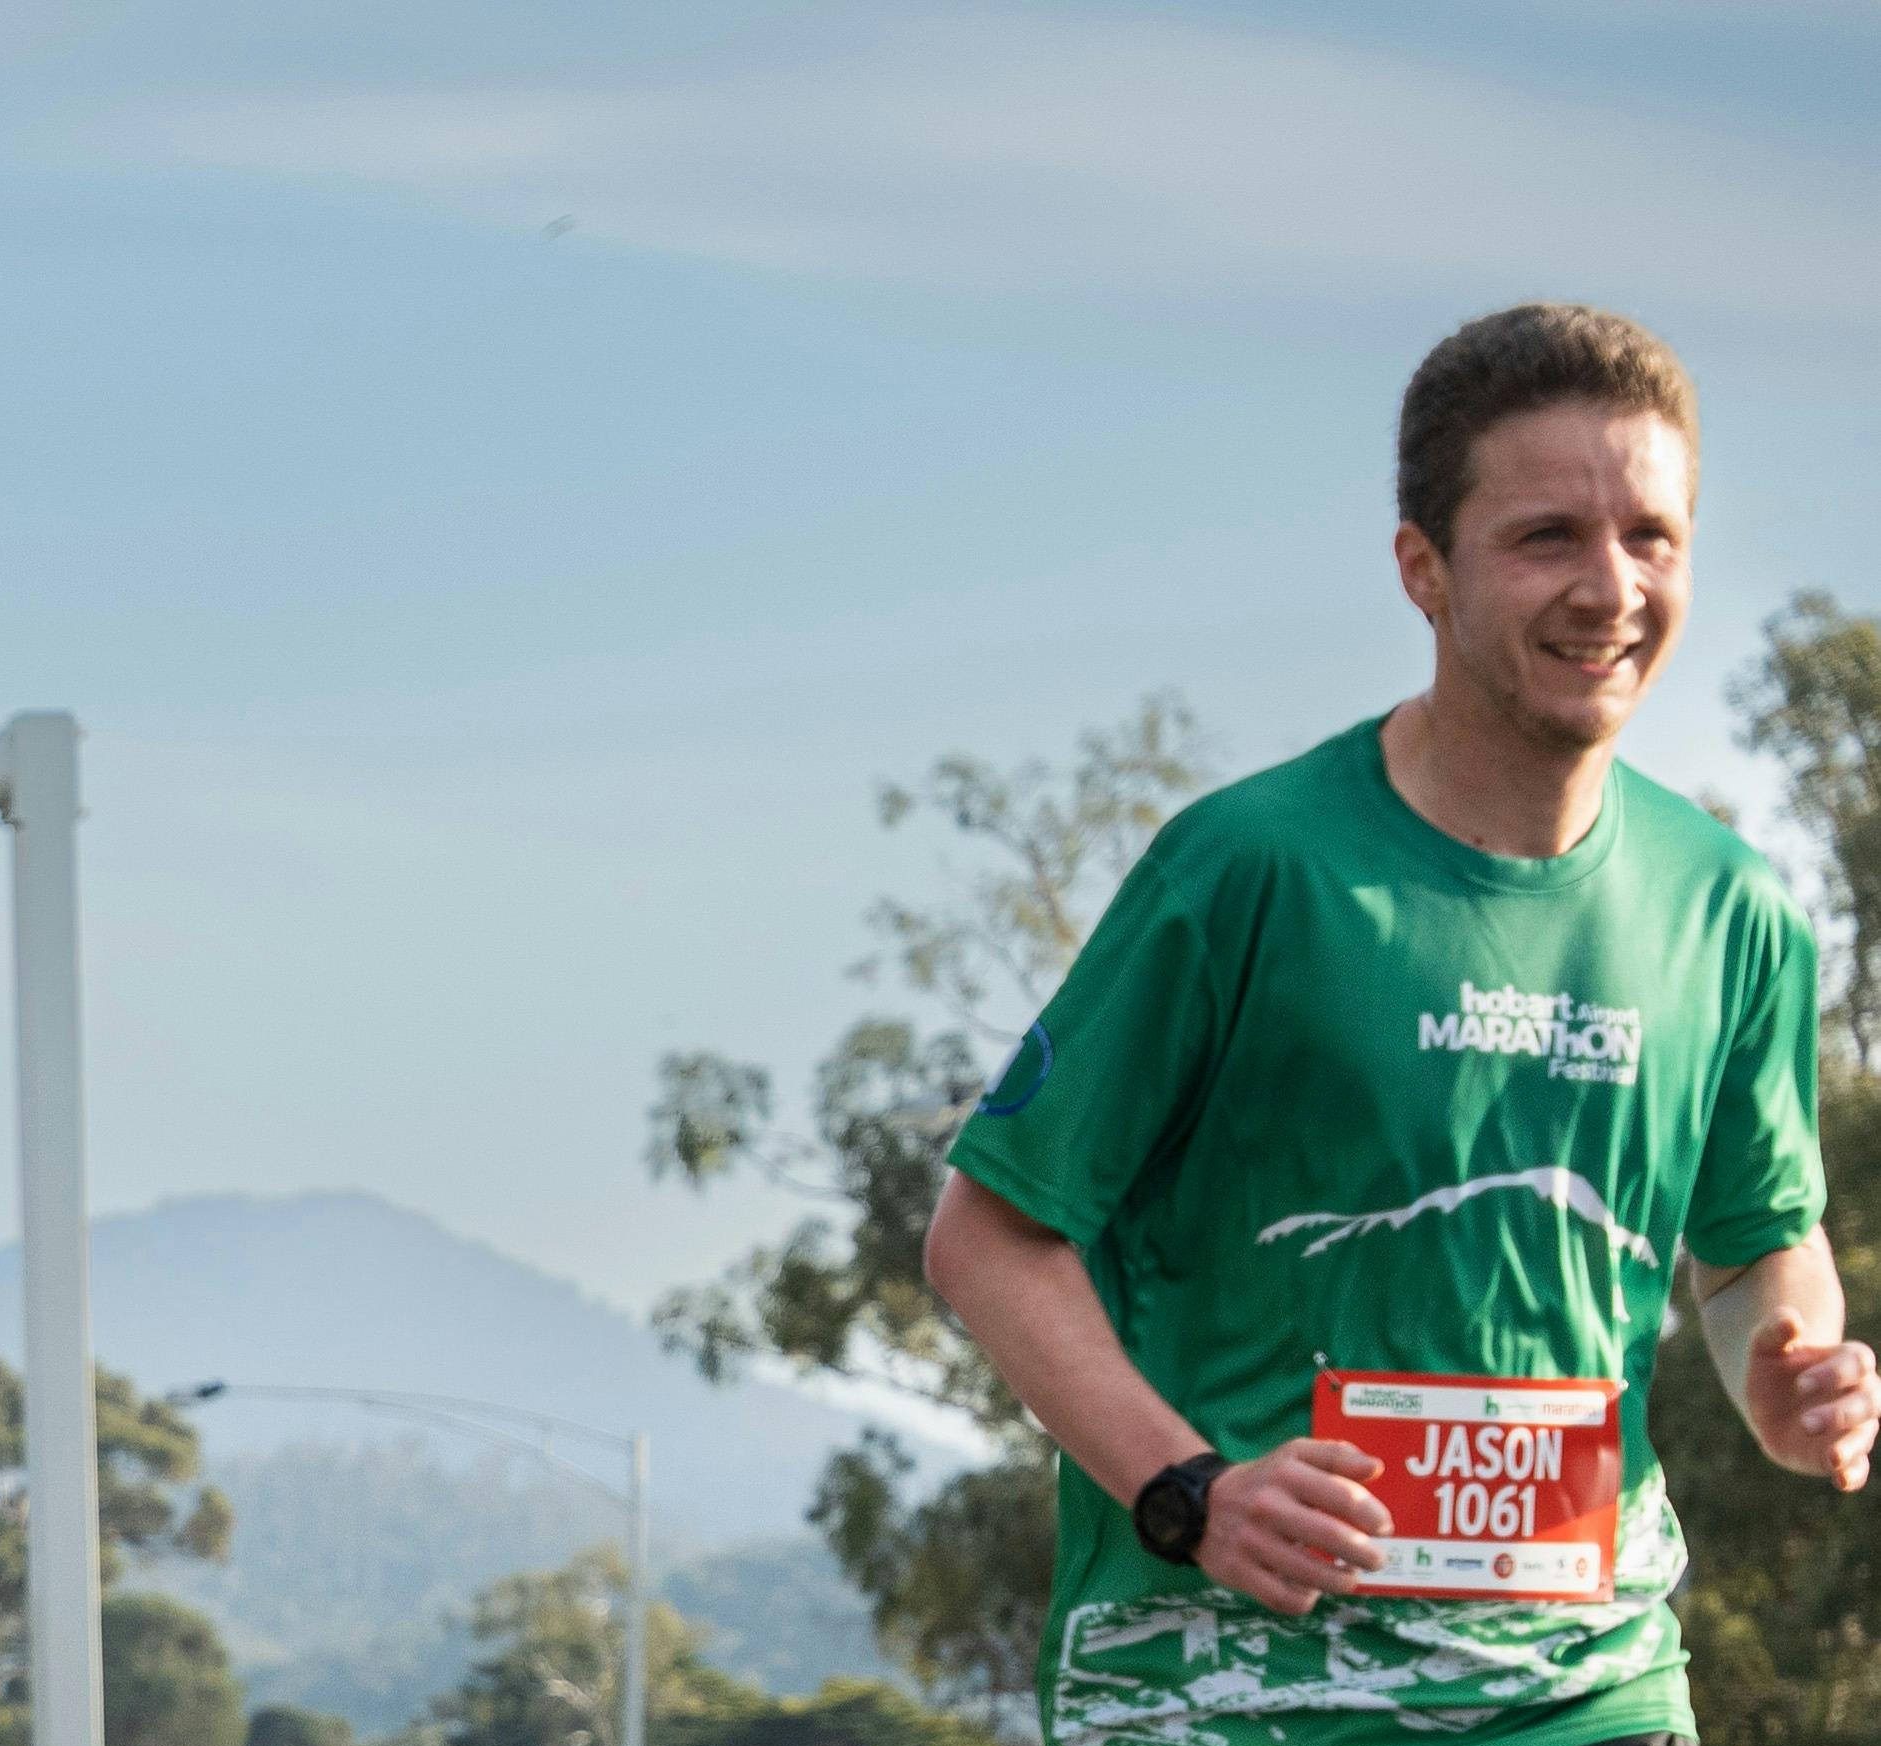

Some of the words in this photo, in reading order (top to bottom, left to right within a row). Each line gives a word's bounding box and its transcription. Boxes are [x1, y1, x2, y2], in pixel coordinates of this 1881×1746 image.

[1460, 981, 1574, 1021] hobart
[1405, 1423, 1564, 1481] JASON
[1434, 1481, 1537, 1538] 1061
